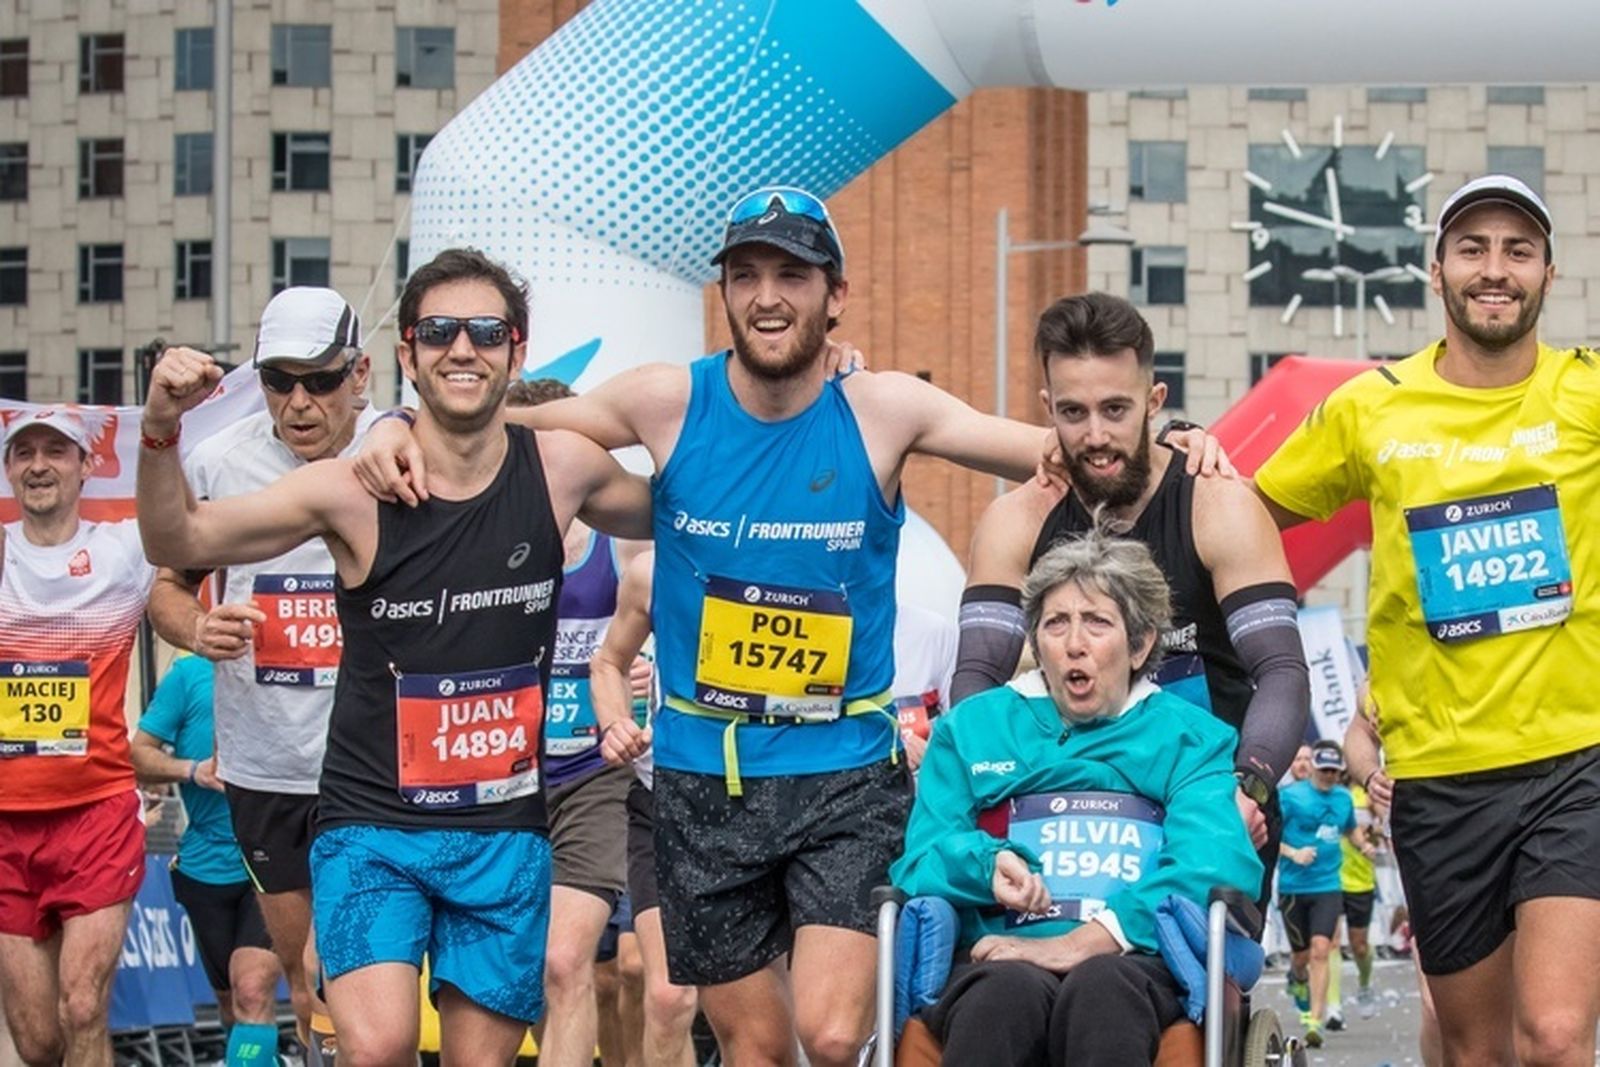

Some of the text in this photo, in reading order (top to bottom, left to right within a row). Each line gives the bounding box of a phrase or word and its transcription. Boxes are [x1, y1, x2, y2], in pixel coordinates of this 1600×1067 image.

[1401, 204, 1422, 229] 3
[1252, 227, 1270, 251] 9
[1465, 500, 1512, 516] ZURICH
[686, 517, 866, 540] asics FRONTRUNNER
[1441, 518, 1543, 564] JAVIER
[1445, 549, 1549, 592] 14922
[386, 579, 555, 619] asics FRONTRUNNER
[763, 591, 809, 606] ZURICH
[752, 611, 808, 640] POL
[728, 640, 828, 676] 15747
[6, 681, 76, 702] MACIEJ
[458, 678, 502, 692] ZURICH
[19, 703, 63, 723] 130
[437, 697, 515, 734] JUAN
[431, 725, 529, 762] 14894
[424, 789, 460, 804] asics
[1070, 799, 1120, 811] ZURICH
[1039, 819, 1142, 849] SILVIA
[1038, 850, 1142, 883] 15945
